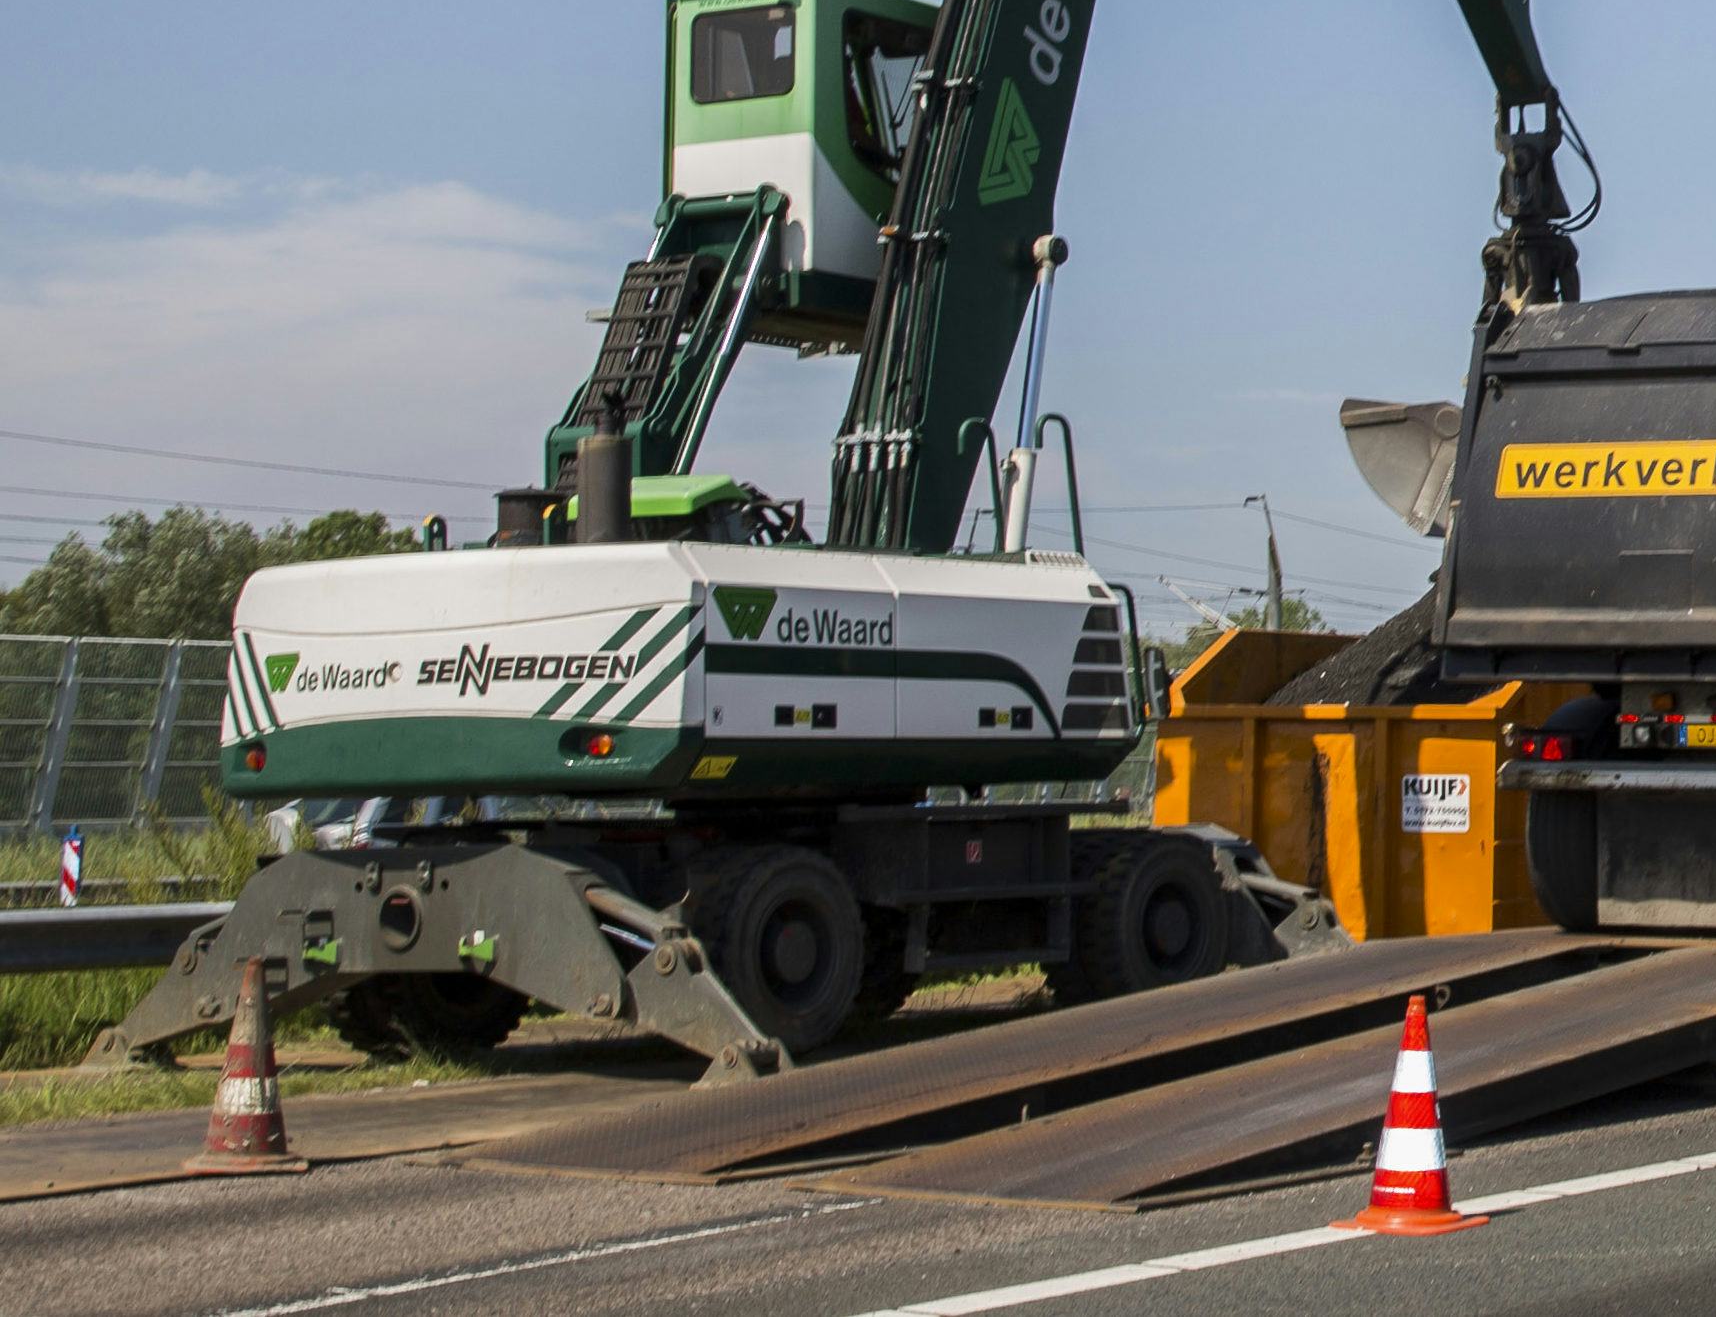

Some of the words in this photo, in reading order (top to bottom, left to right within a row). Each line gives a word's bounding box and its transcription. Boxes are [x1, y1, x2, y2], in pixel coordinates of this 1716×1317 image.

[777, 598, 809, 643] de
[813, 599, 893, 646] Waard
[297, 666, 318, 692] de
[321, 661, 388, 690] Waard
[417, 643, 636, 696] SENNEBOGEN
[1405, 778, 1458, 800] KUIJF
